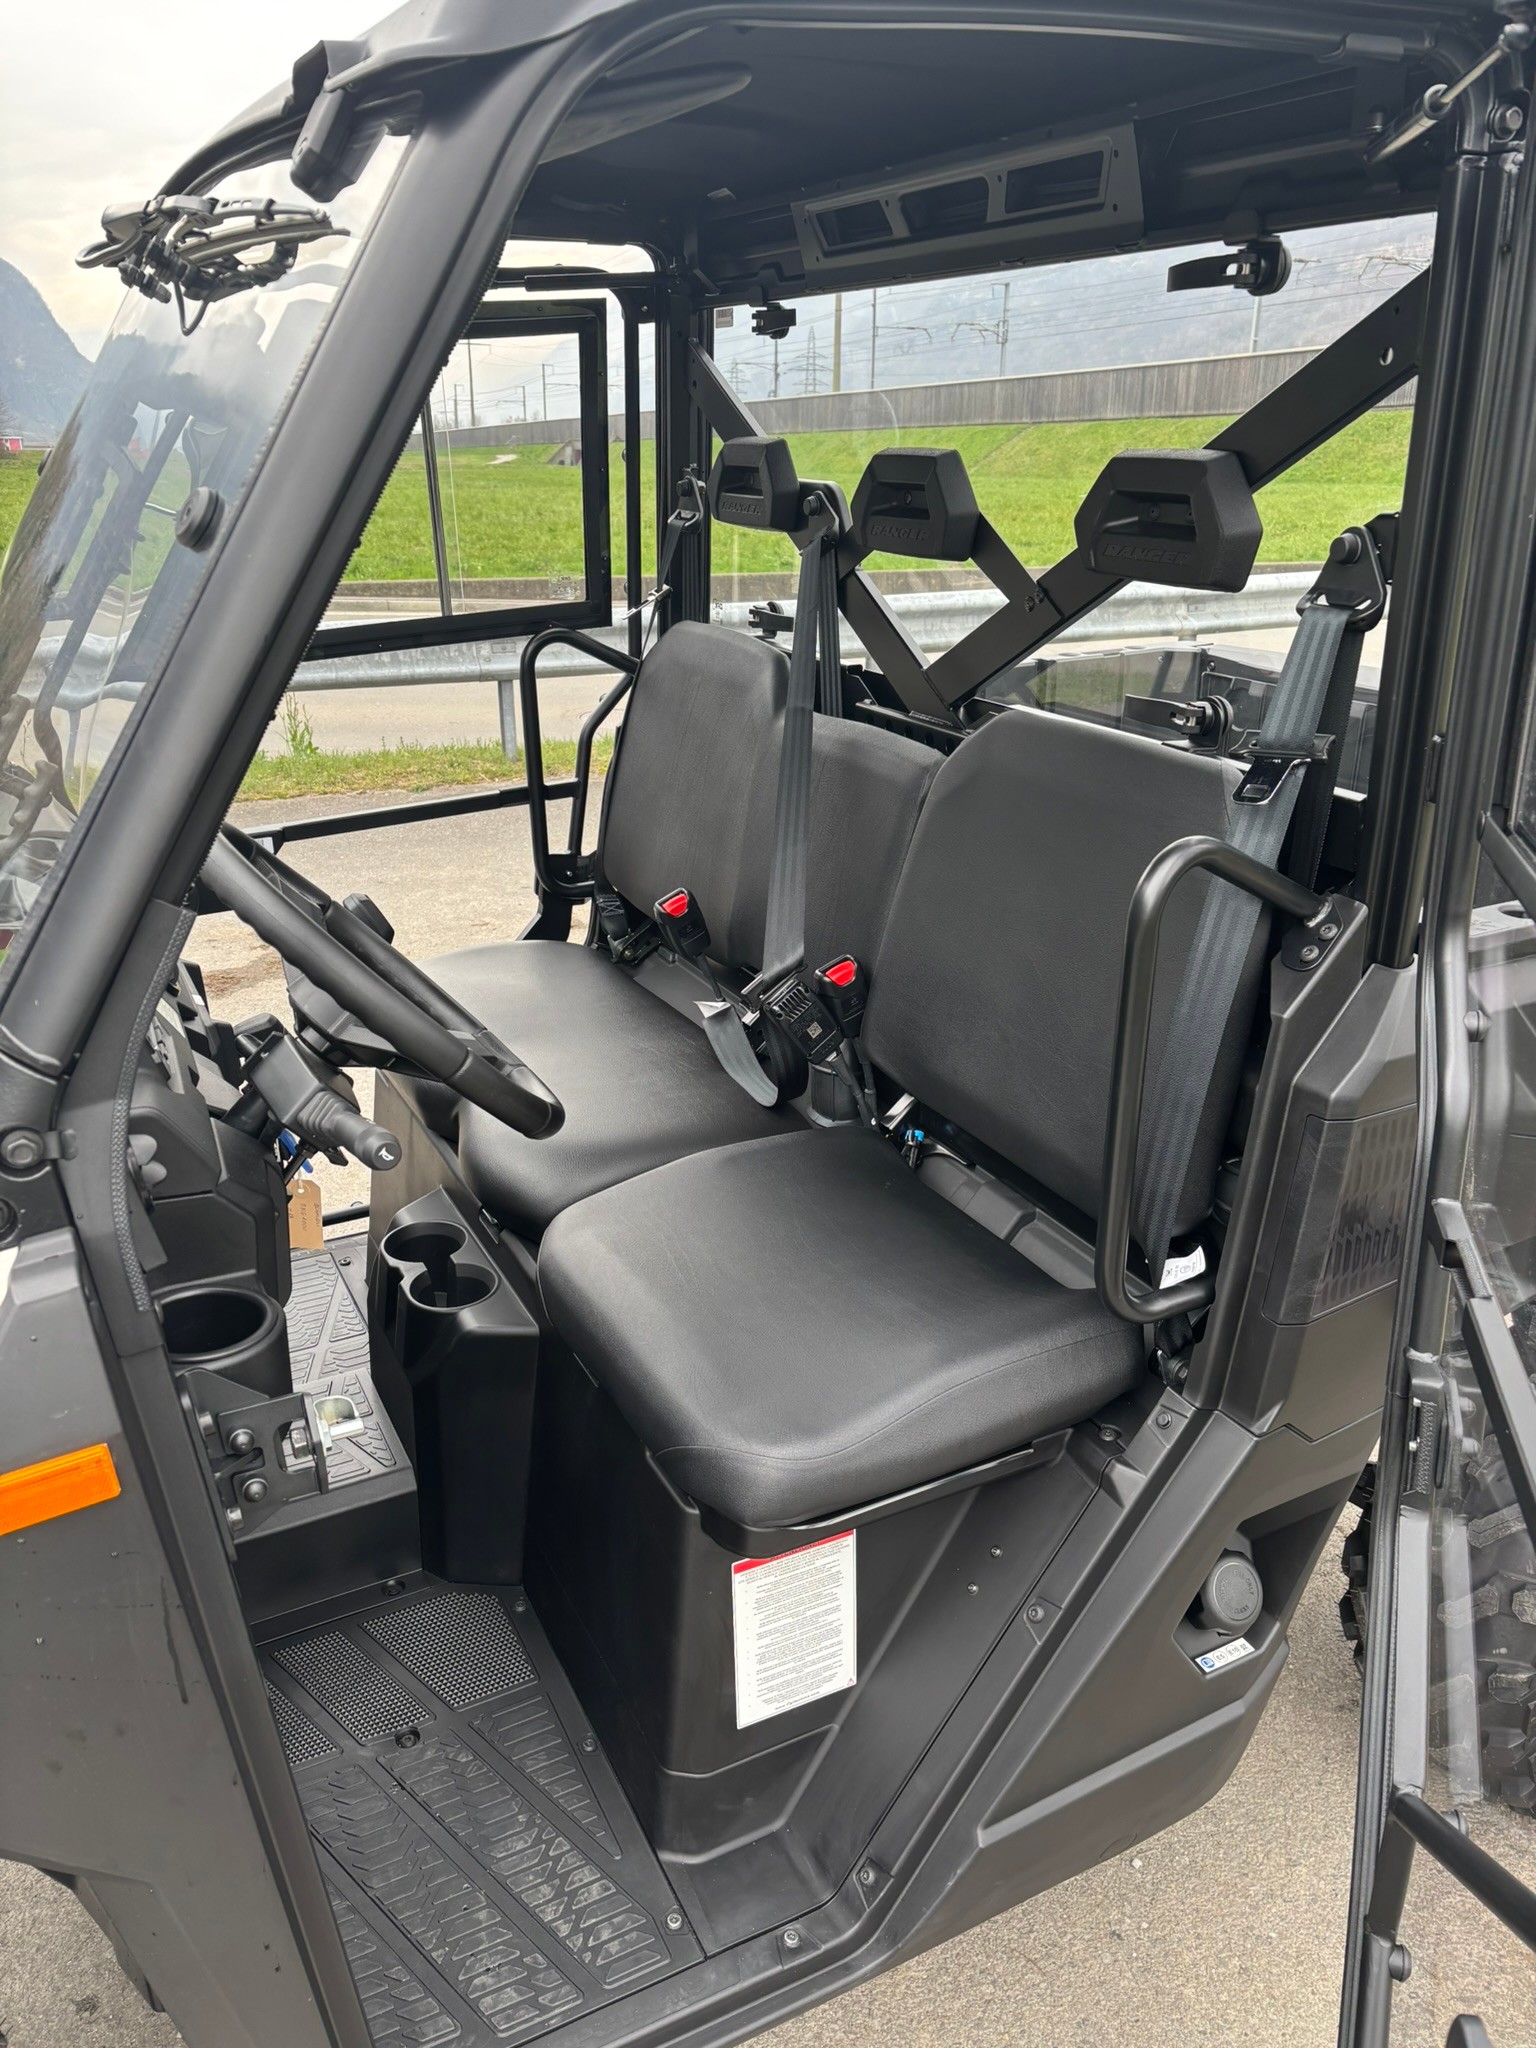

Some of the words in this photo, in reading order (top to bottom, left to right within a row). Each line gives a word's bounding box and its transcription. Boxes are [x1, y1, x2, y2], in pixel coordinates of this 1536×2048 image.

[721, 500, 761, 516] RANGER
[870, 524, 929, 542] RANGER
[1102, 543, 1193, 567] RANGER
